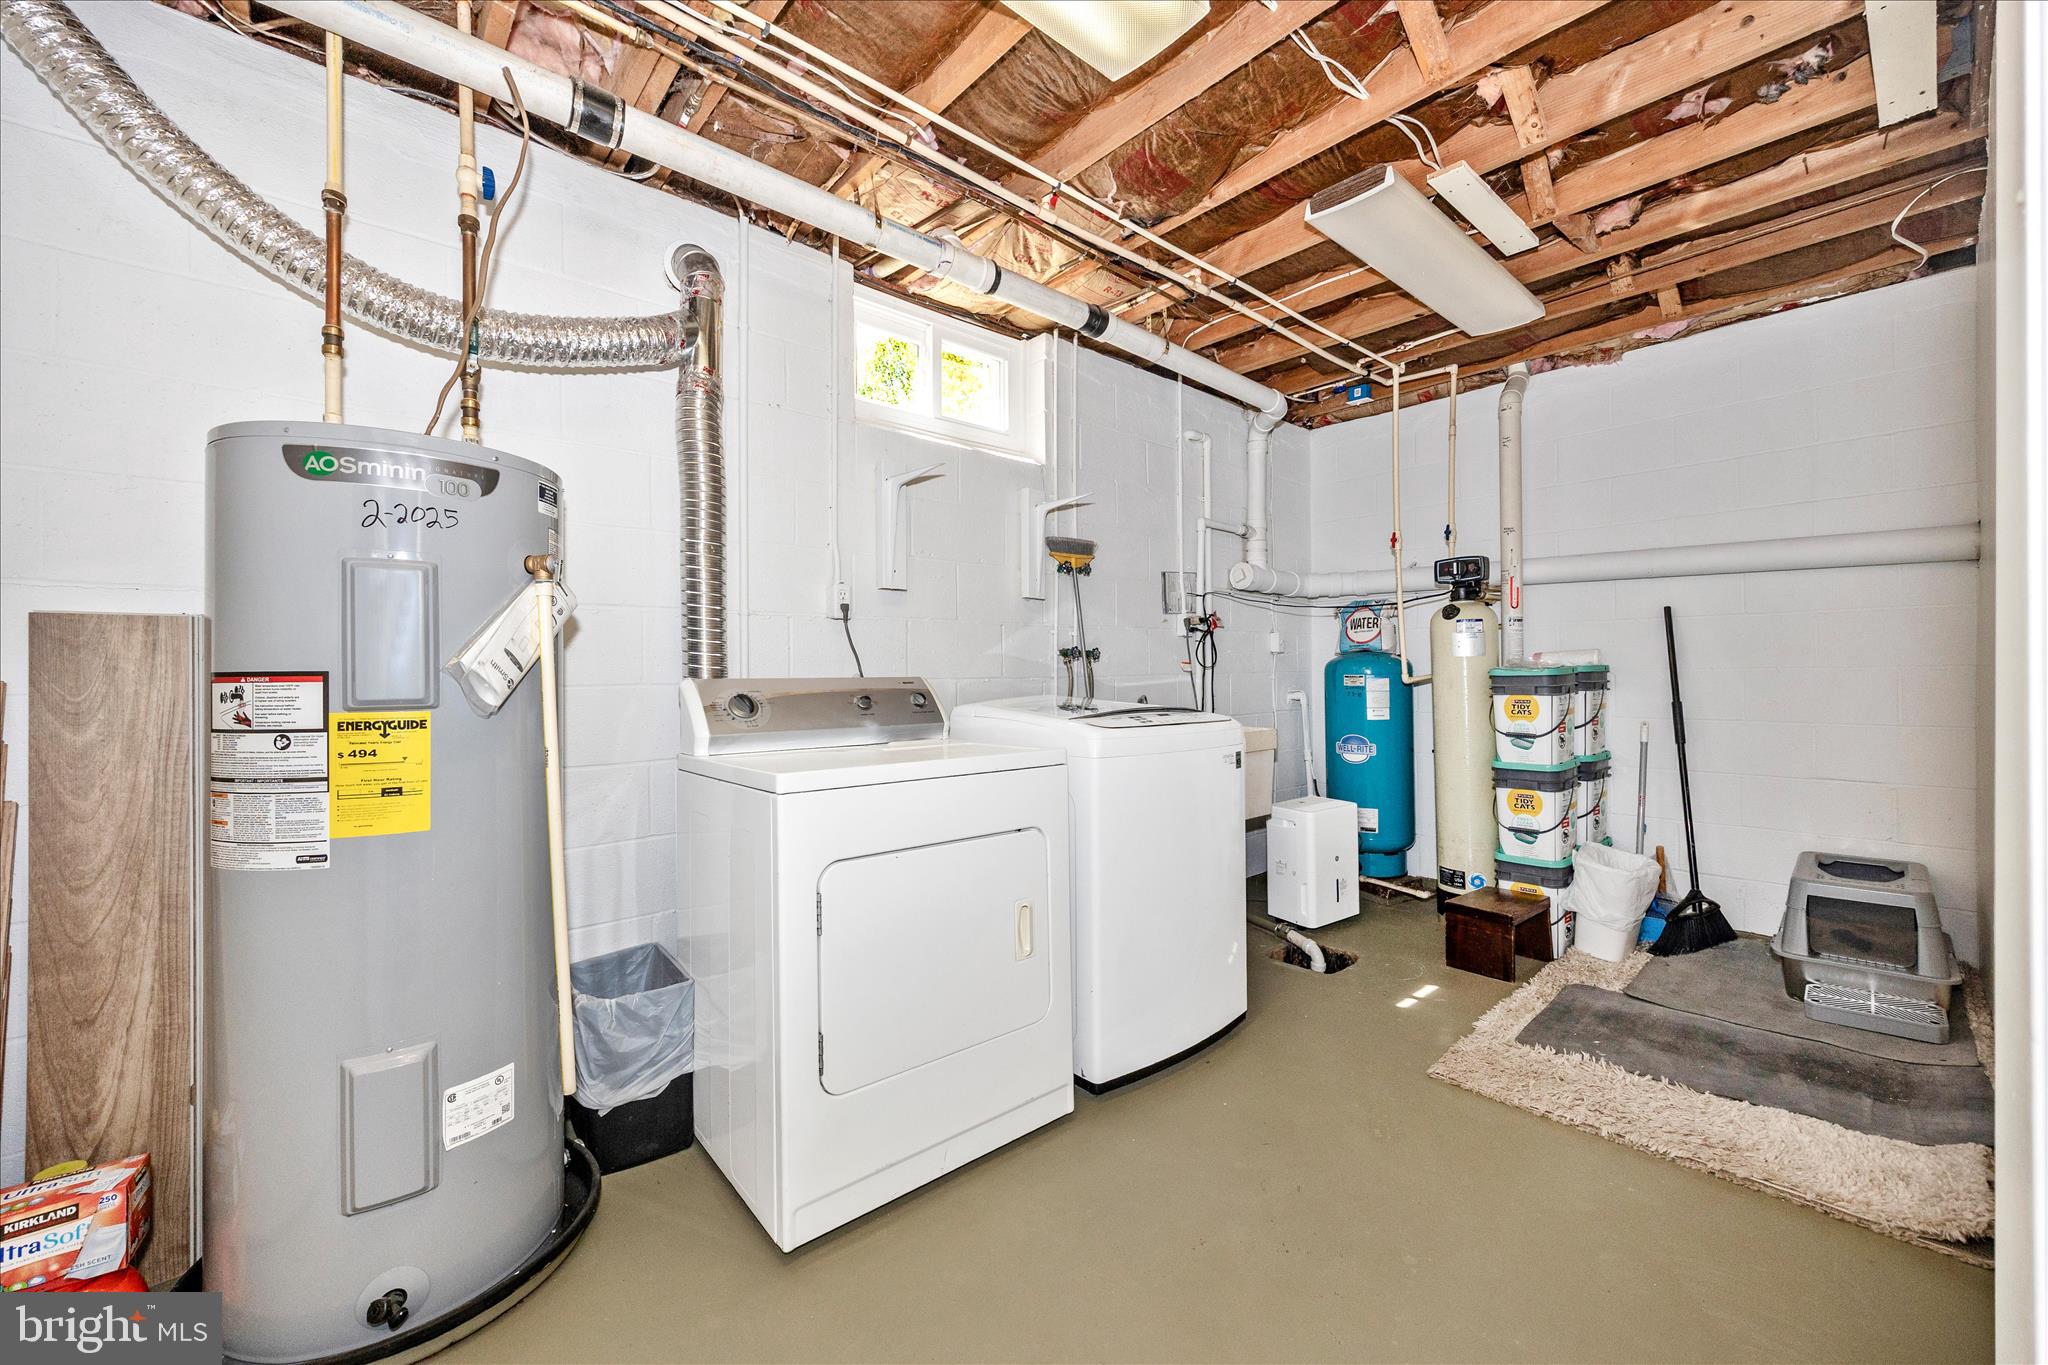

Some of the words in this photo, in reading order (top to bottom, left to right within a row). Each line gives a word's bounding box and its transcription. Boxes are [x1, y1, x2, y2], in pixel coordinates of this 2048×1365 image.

[440, 480, 469, 498] 100
[361, 499, 460, 529] 2-2025
[1350, 616, 1379, 631] WATER
[347, 749, 378, 759] 494
[1337, 744, 1374, 754] WELL-RITE
[99, 1193, 118, 1204] 250
[3, 1205, 77, 1235] KIRKLAND
[87, 1254, 112, 1266] SCENT
